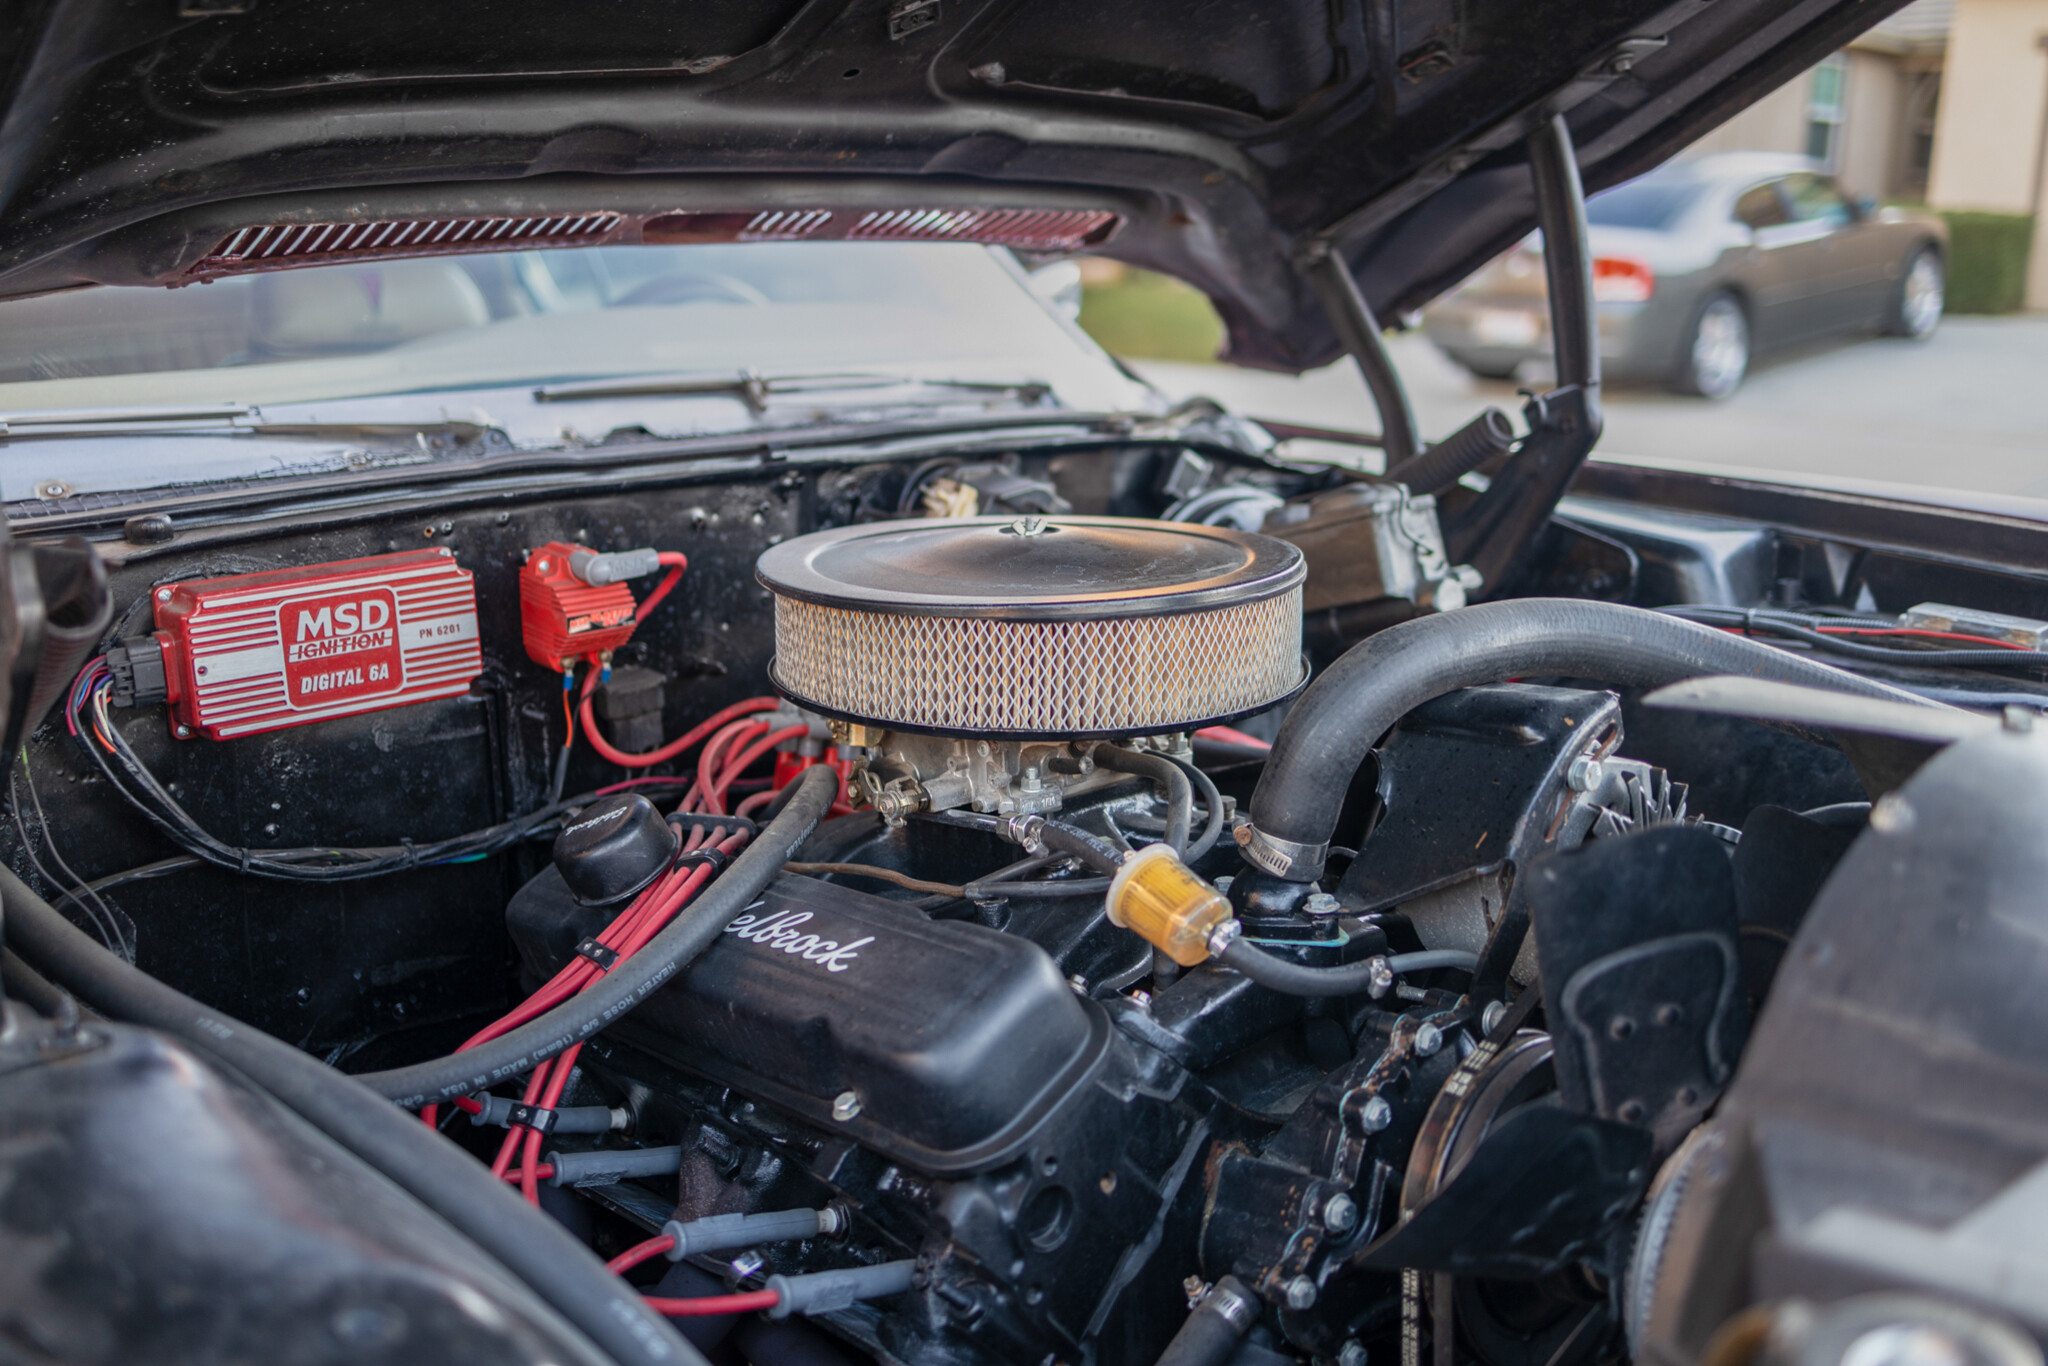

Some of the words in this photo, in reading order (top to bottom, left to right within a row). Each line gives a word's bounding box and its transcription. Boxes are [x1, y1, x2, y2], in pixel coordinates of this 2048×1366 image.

[296, 599, 390, 642] MSD
[419, 628, 433, 639] PN
[436, 623, 461, 636] 6201
[297, 631, 386, 660] IGNITION
[300, 668, 365, 695] DIGITAL
[368, 662, 389, 682] 6A
[724, 900, 876, 973] elbrock
[637, 961, 677, 996] HEATER
[602, 994, 634, 1021] HOSE
[532, 1033, 574, 1061] (16mm)
[473, 1074, 488, 1087] IN
[491, 1056, 528, 1078] MADE
[440, 1081, 469, 1097] USA
